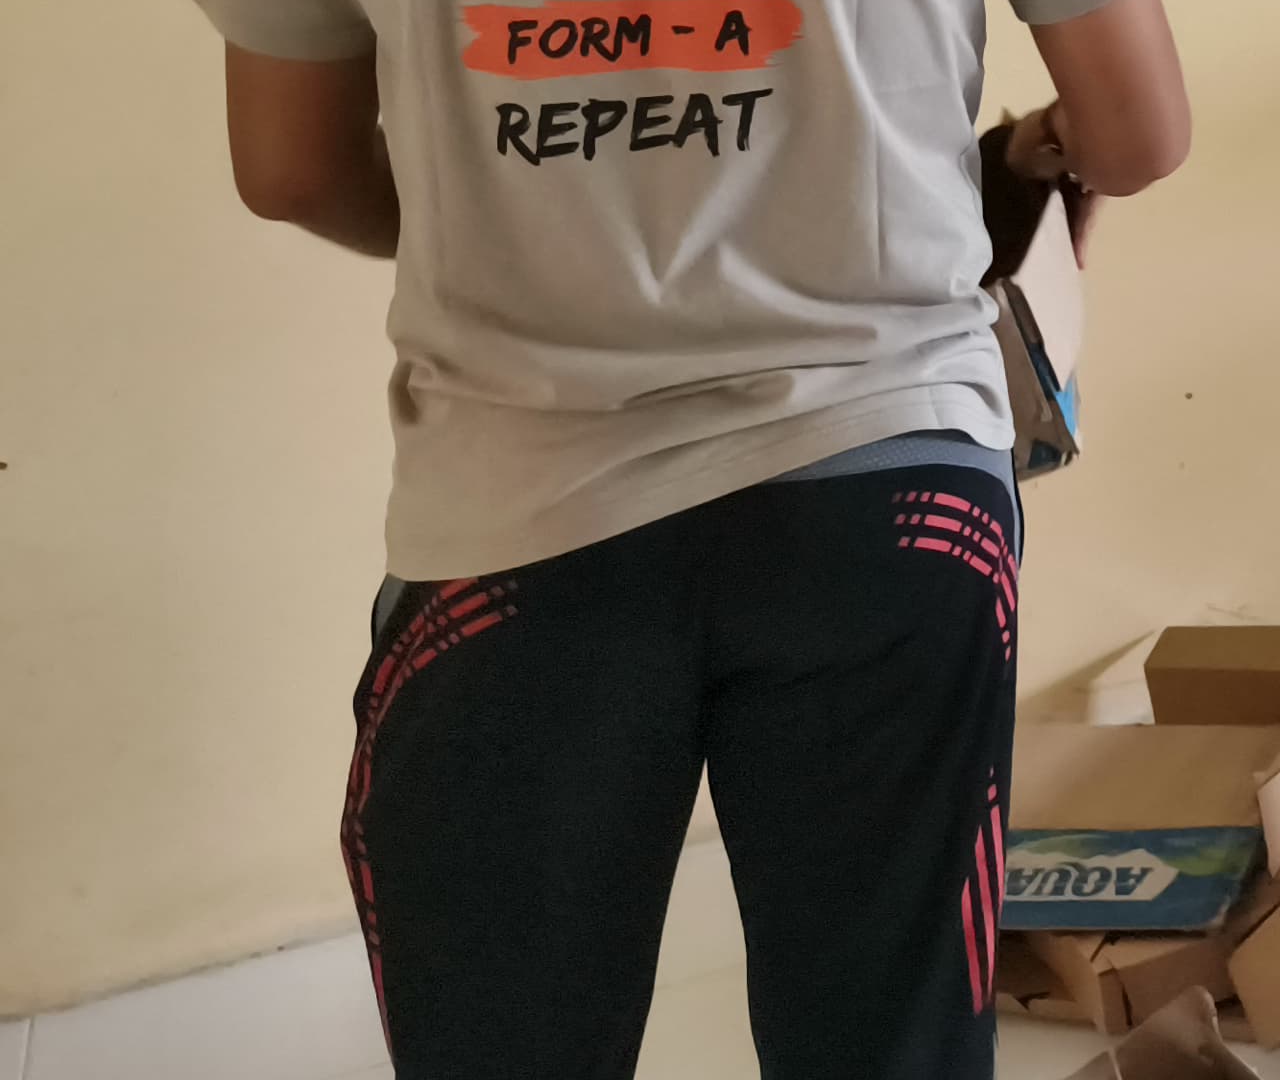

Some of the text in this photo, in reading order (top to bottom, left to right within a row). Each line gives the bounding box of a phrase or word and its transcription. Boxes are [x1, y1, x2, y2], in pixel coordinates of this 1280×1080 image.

[506, 14, 651, 65] FORM
[714, 10, 752, 56] A
[496, 87, 774, 166] REPEAT
[1006, 861, 1155, 898] AQUA
